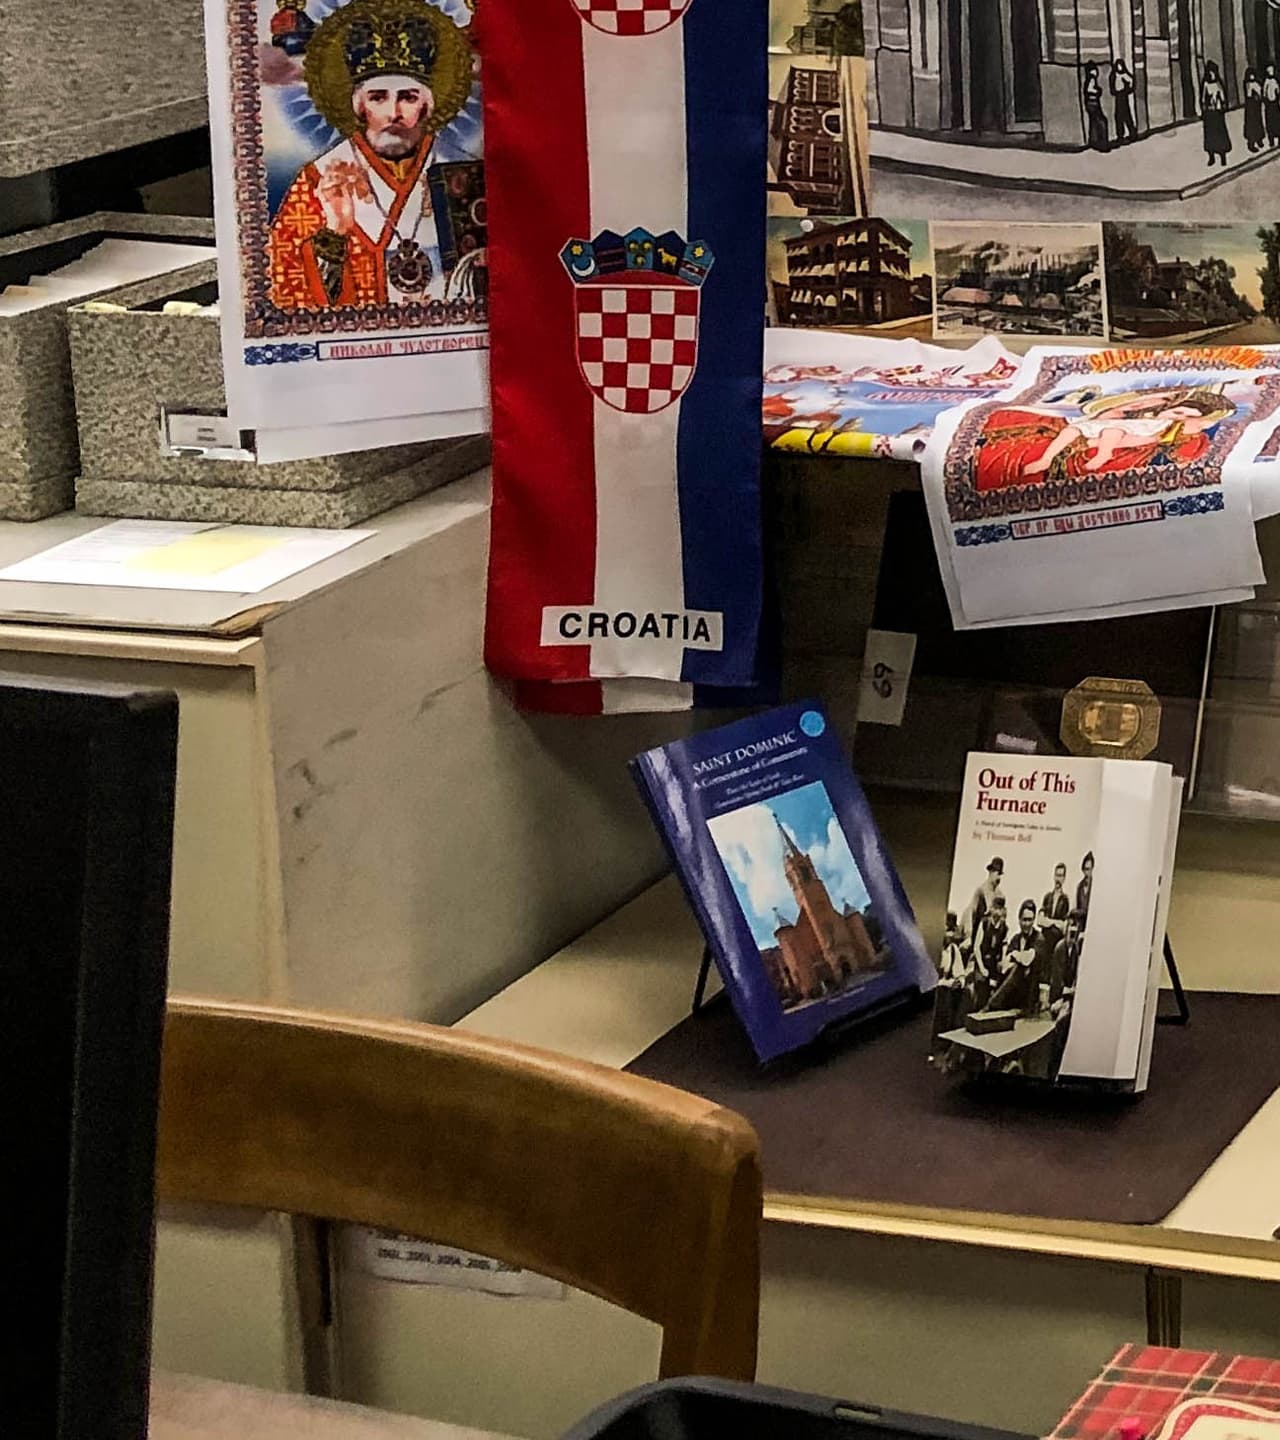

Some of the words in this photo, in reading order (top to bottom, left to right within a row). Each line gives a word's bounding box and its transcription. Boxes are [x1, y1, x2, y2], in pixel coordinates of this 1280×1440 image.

[559, 612, 710, 642] CROATIA
[692, 751, 732, 776] SAINT
[734, 729, 799, 761] DOMINIC
[977, 767, 1014, 789] Out
[1019, 770, 1038, 791] of
[1042, 771, 1077, 794] This
[976, 790, 1047, 815] Furnace
